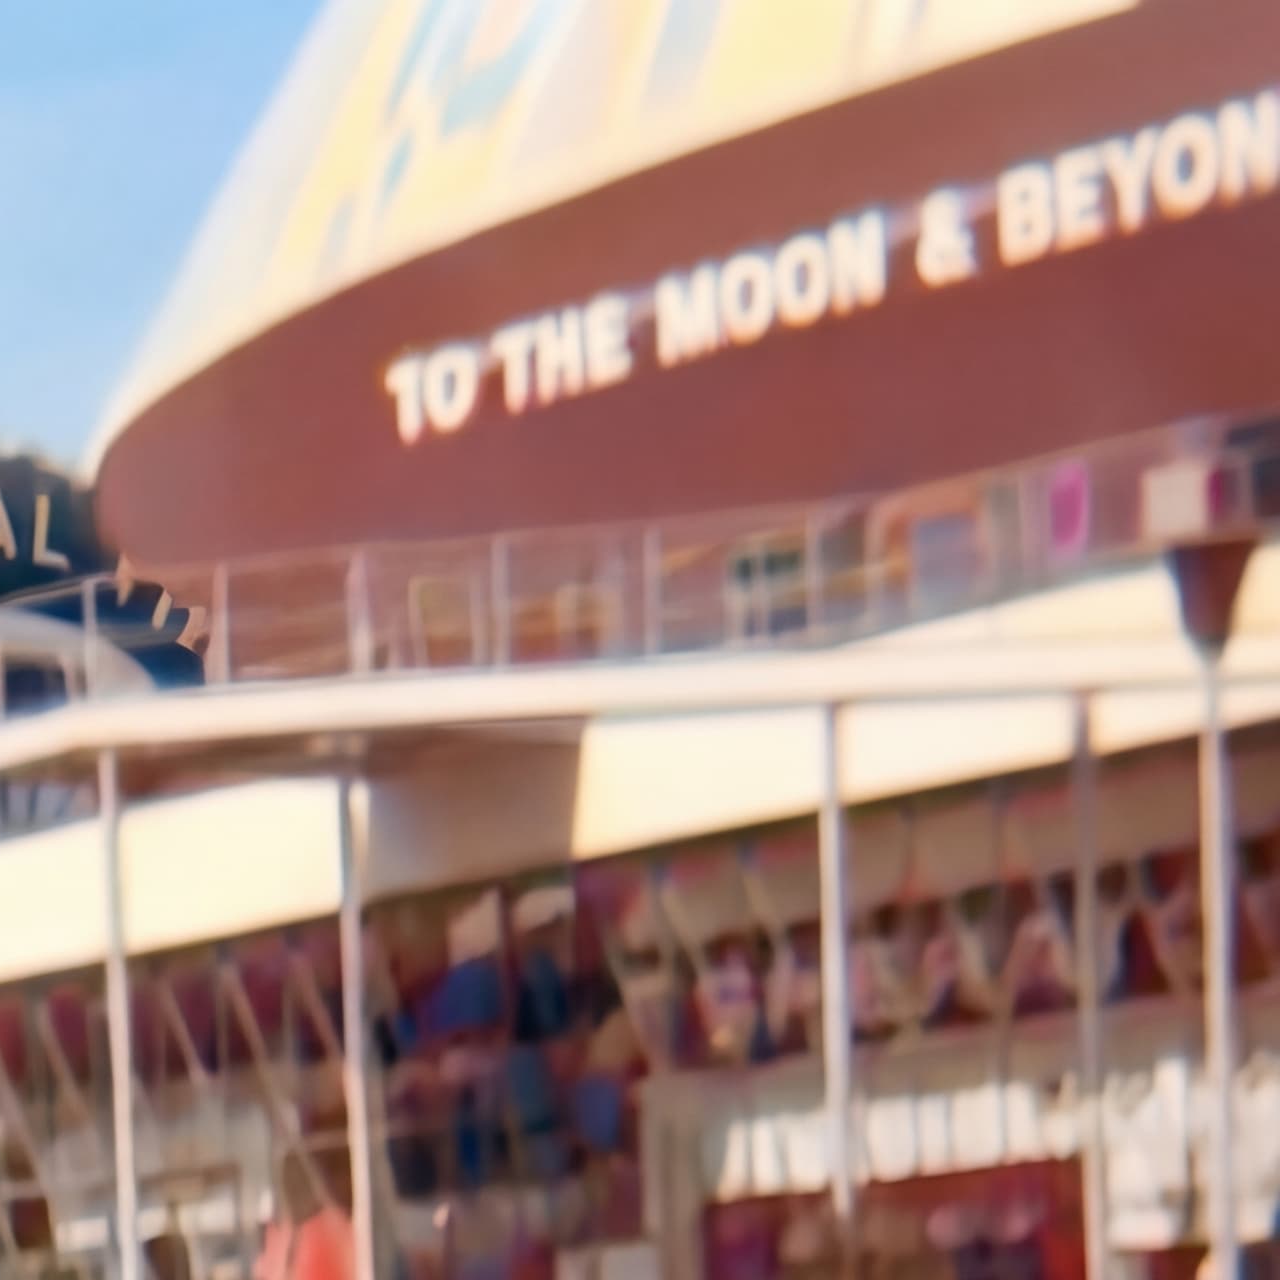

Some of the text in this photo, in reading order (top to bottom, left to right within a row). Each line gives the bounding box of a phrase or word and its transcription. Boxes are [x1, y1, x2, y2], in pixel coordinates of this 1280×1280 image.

[489, 292, 633, 416] THE
[653, 207, 887, 370] MOON
[914, 188, 978, 289] &
